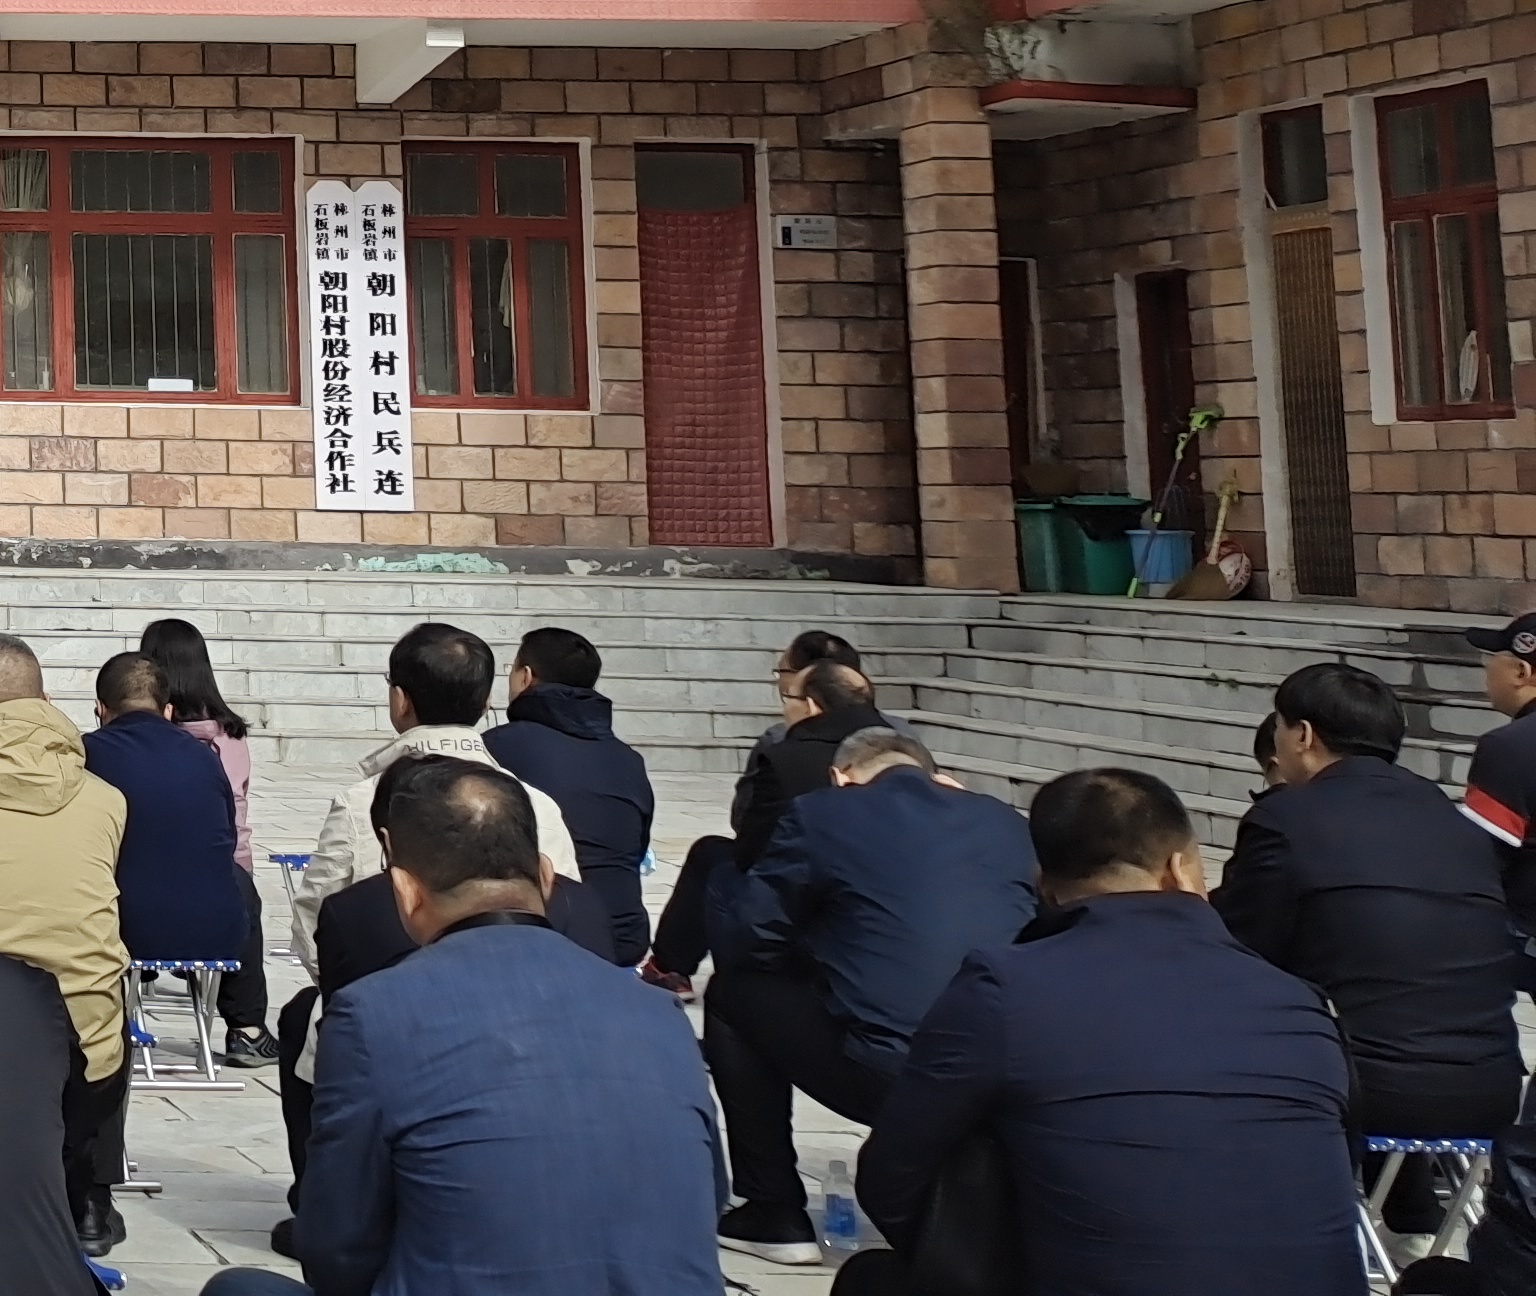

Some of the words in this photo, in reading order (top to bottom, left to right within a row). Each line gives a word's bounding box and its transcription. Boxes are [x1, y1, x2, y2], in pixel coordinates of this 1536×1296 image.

[314, 203, 331, 261] 石板岩镇
[361, 203, 378, 262] 石板岩镇
[381, 203, 398, 262] 林州市
[319, 270, 358, 494] 朝阳村股份经济合作社
[366, 272, 406, 496] 朝阳村民兵连
